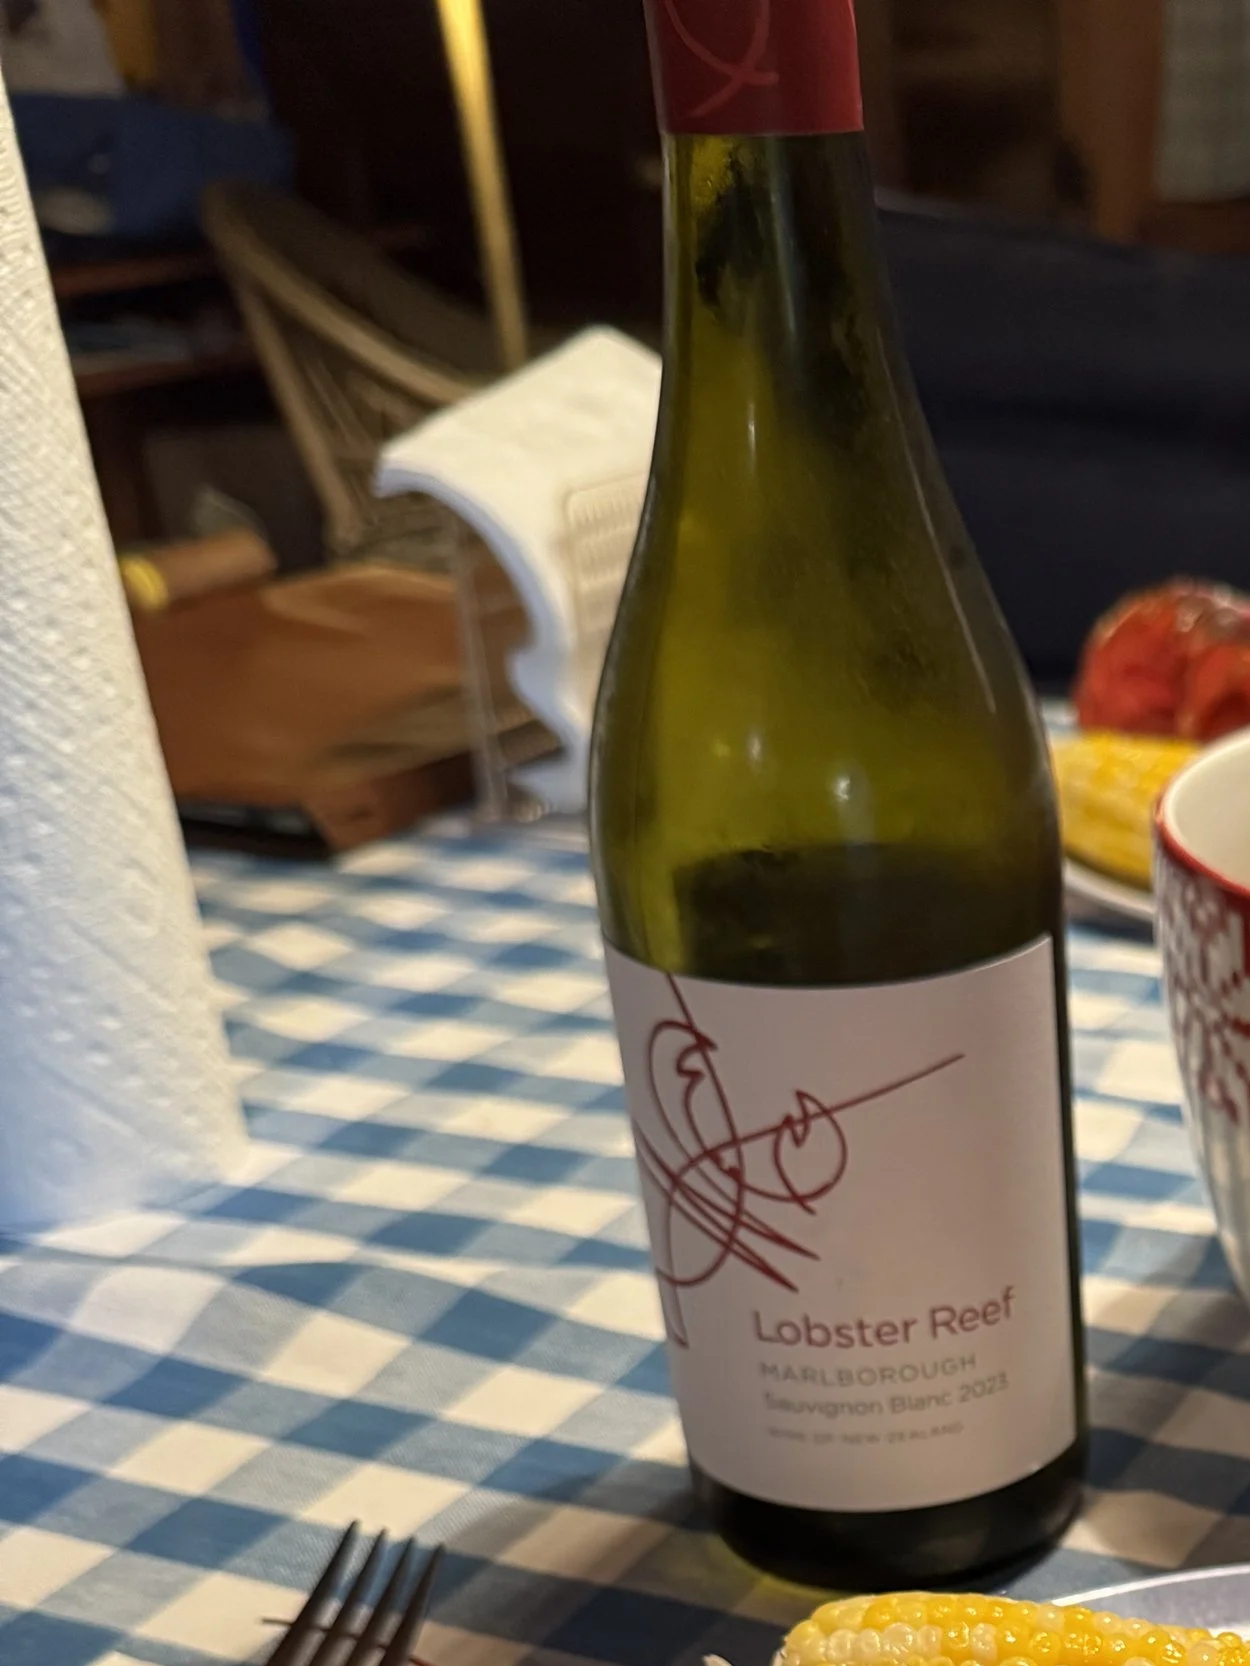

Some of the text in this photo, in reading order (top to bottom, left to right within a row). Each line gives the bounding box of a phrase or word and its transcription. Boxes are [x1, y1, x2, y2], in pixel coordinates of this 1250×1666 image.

[753, 1285, 1016, 1349] Lobster Reef
[759, 1353, 977, 1388] MARLBOROUGH
[763, 1391, 884, 1418] Sauvignon
[889, 1391, 953, 1415] Blanc
